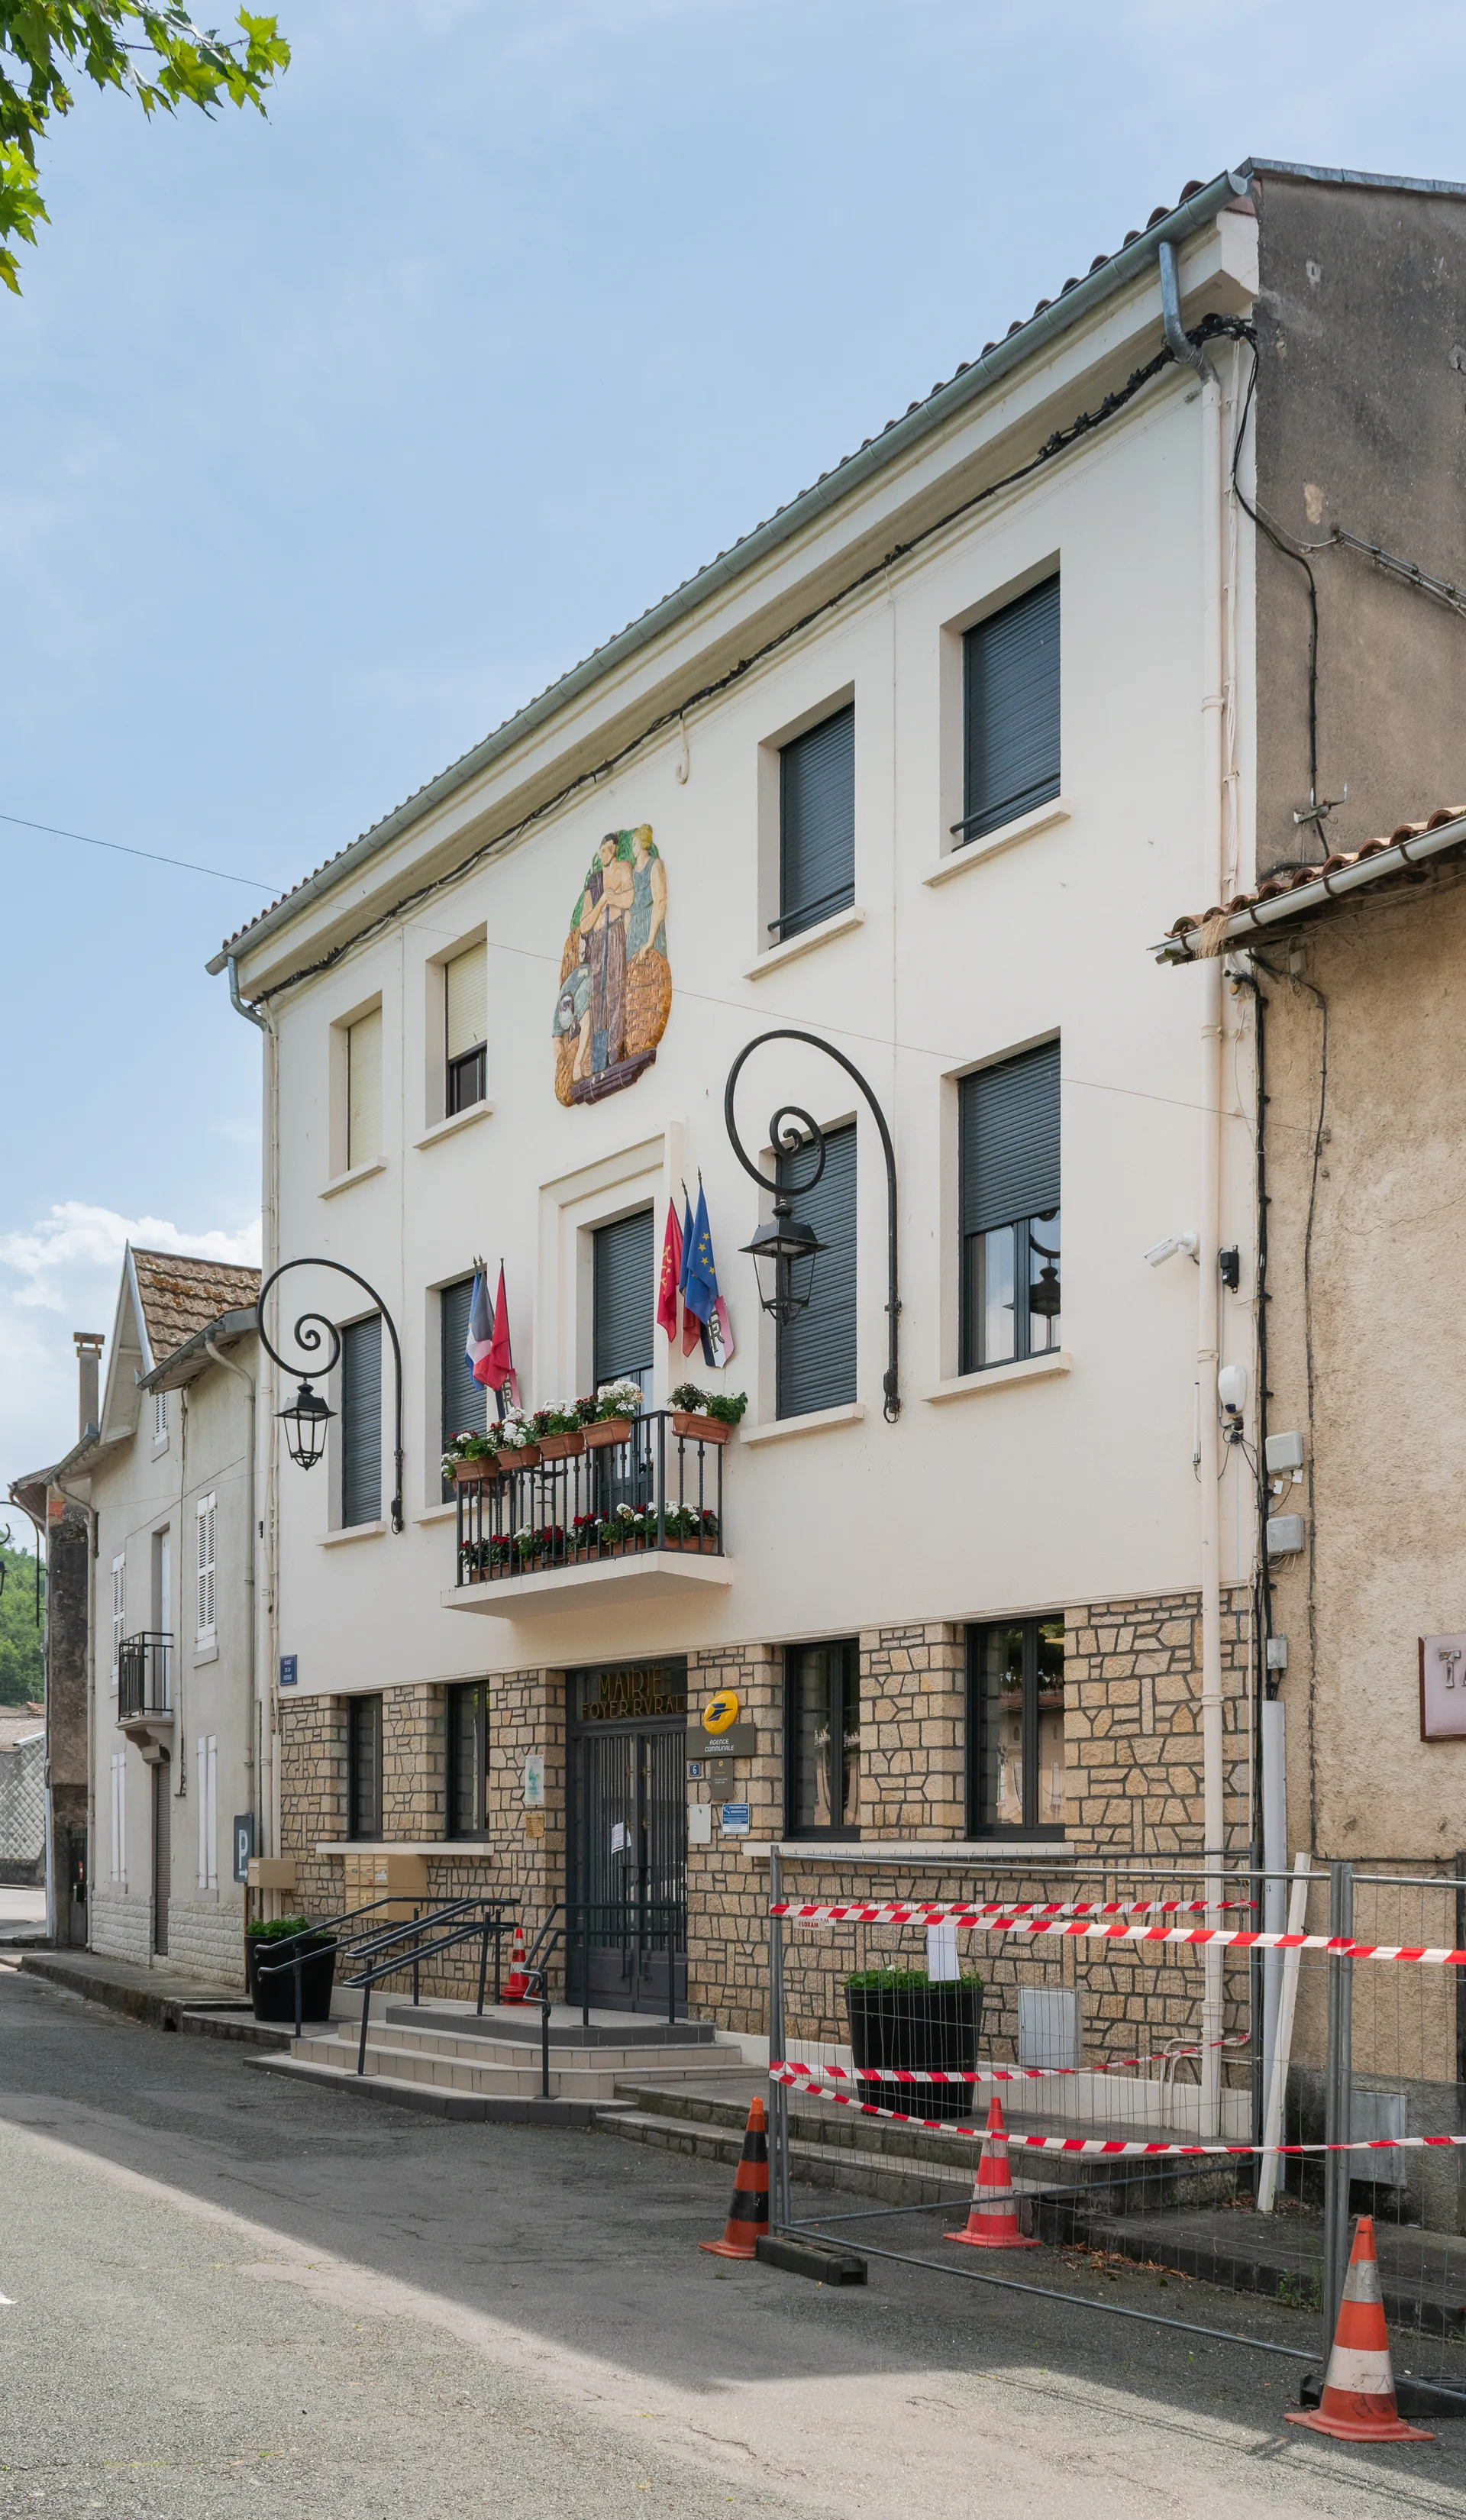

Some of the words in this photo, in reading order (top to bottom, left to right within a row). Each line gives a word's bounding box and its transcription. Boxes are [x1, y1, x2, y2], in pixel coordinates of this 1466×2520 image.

[599, 1666, 665, 1701] MAIRIE
[1439, 1649, 1466, 1688] T
[581, 1699, 628, 1720] FOYER
[693, 1766, 697, 1775] 6
[238, 1829, 248, 1869] P
